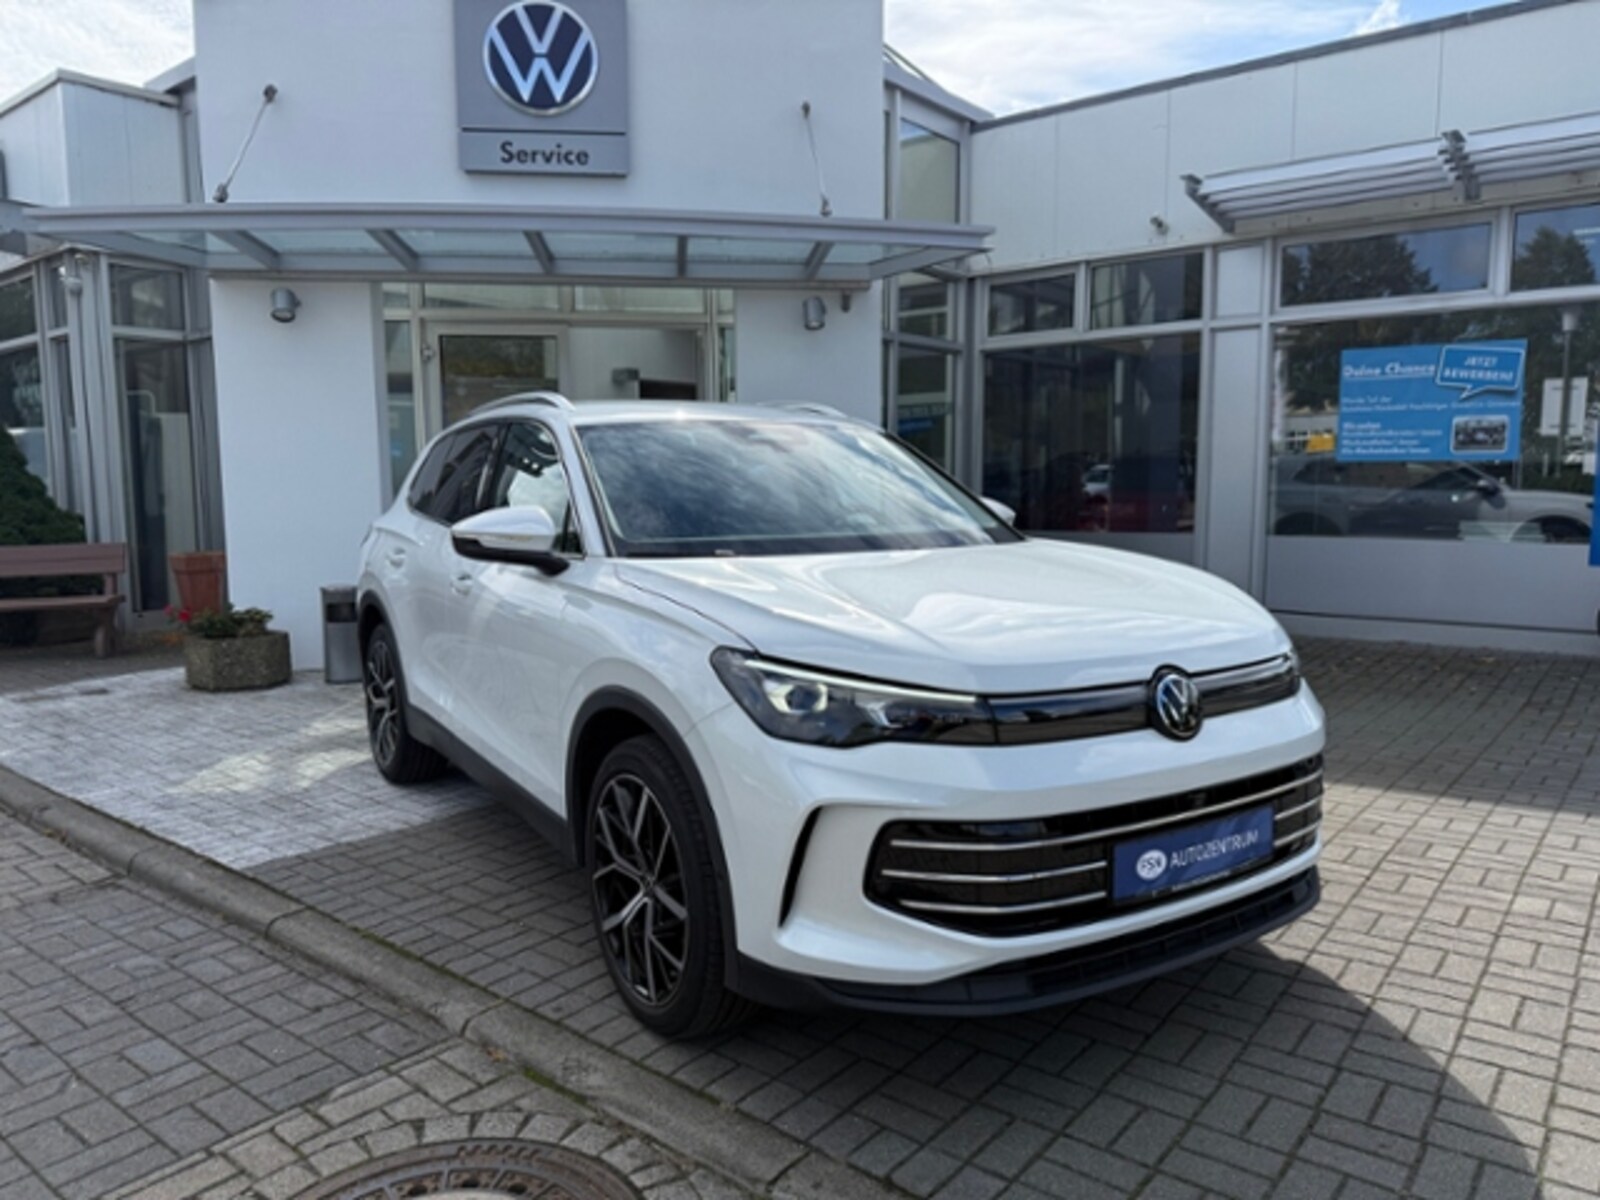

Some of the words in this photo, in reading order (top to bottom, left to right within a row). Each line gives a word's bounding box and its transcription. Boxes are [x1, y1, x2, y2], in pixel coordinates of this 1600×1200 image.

[500, 140, 589, 165] Service
[1464, 356, 1498, 367] JETZT
[1169, 830, 1259, 868] AUTOZENTRUM
